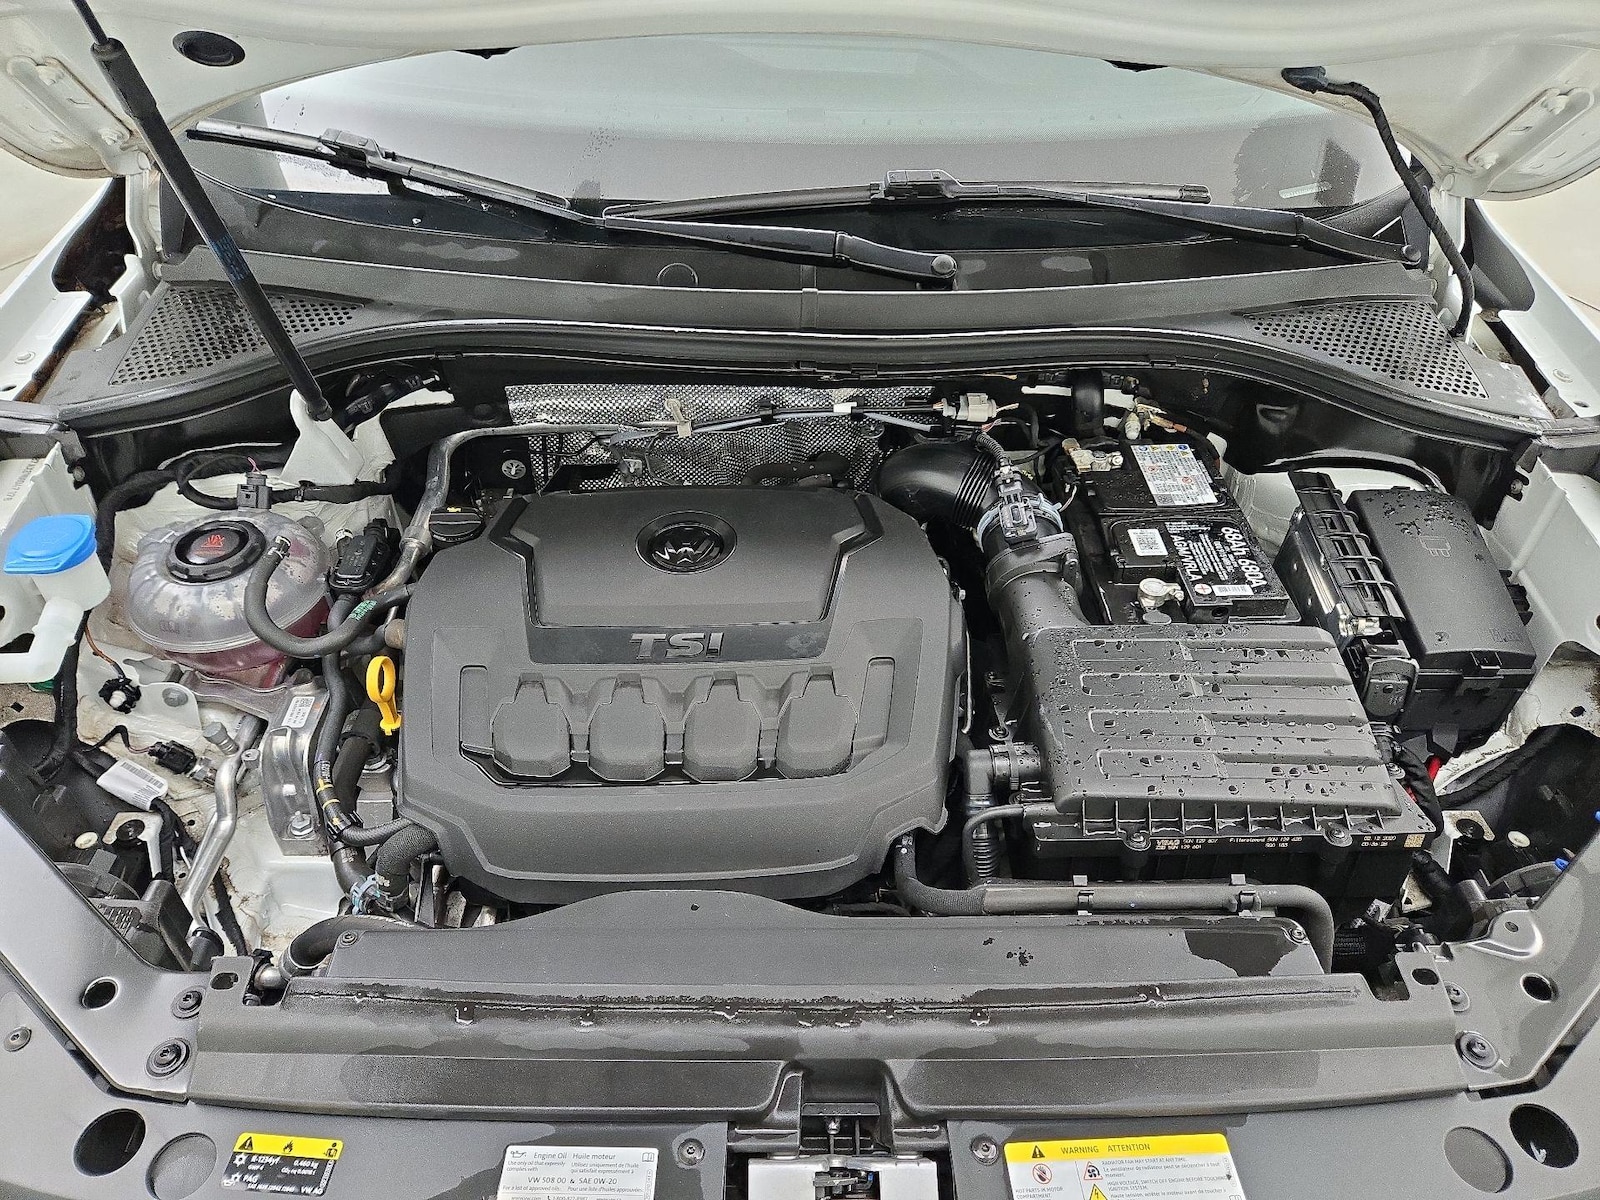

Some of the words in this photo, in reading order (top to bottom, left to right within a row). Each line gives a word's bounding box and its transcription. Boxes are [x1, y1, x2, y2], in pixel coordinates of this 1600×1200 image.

[1221, 526, 1250, 556] 68Ah
[1238, 558, 1268, 588] 680A
[630, 632, 724, 660] TSI
[1061, 1146, 1099, 1154] WARNING
[1107, 1144, 1150, 1152] ATTENTION
[243, 1174, 259, 1183] PAG
